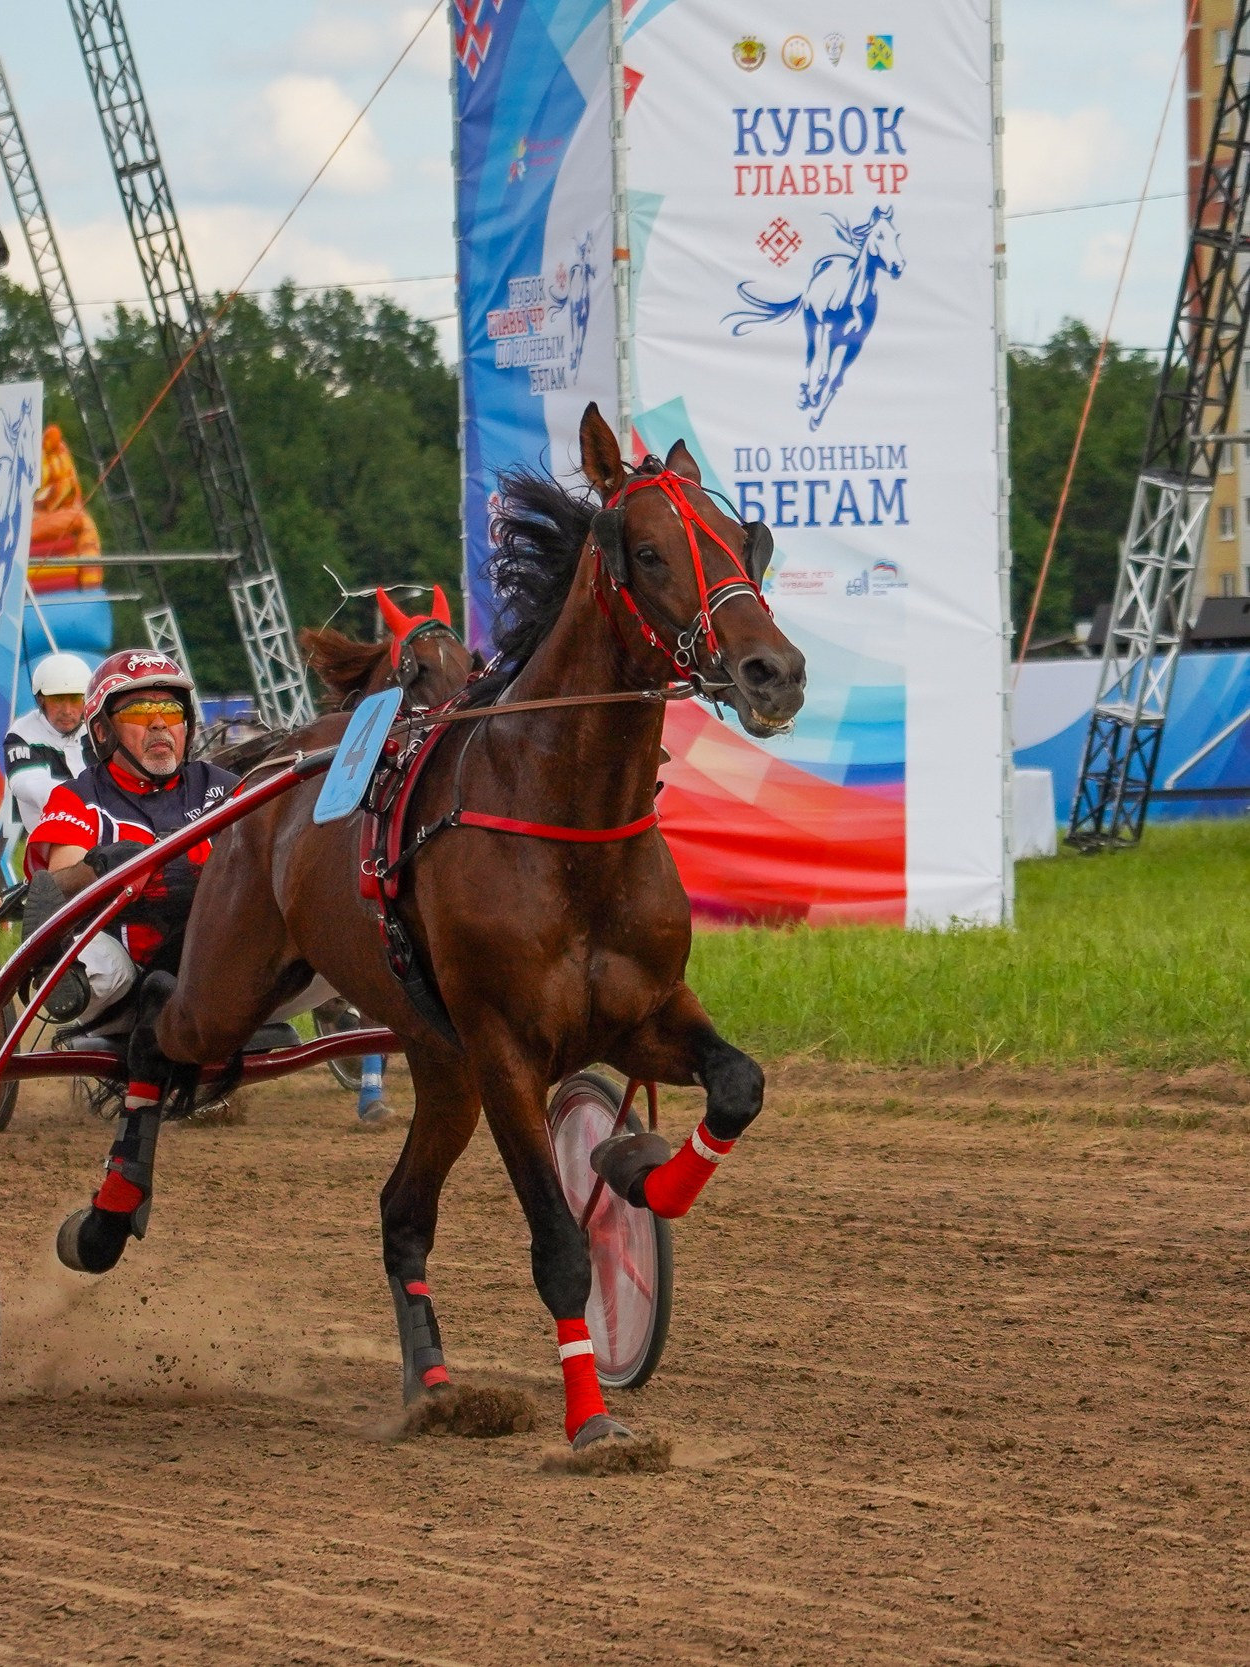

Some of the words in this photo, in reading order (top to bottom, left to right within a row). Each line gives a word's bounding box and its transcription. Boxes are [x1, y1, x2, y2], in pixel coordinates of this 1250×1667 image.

[732, 106, 907, 156] КУБОК
[734, 164, 854, 196] ГЛАВЫ
[863, 164, 909, 194] ЧР
[509, 279, 546, 307] КУБОК
[488, 310, 528, 338] ГЛАВЫ
[529, 307, 545, 332] ЧР
[496, 342, 510, 367] ПО
[513, 336, 565, 365] КОННЫМ
[530, 367, 567, 393] БЕГАМ
[734, 447, 771, 473] ПО
[780, 444, 909, 472] КОННЫМ
[734, 478, 910, 528] БЕГАМ
[7, 746, 30, 762] TM
[341, 699, 386, 781] 4
